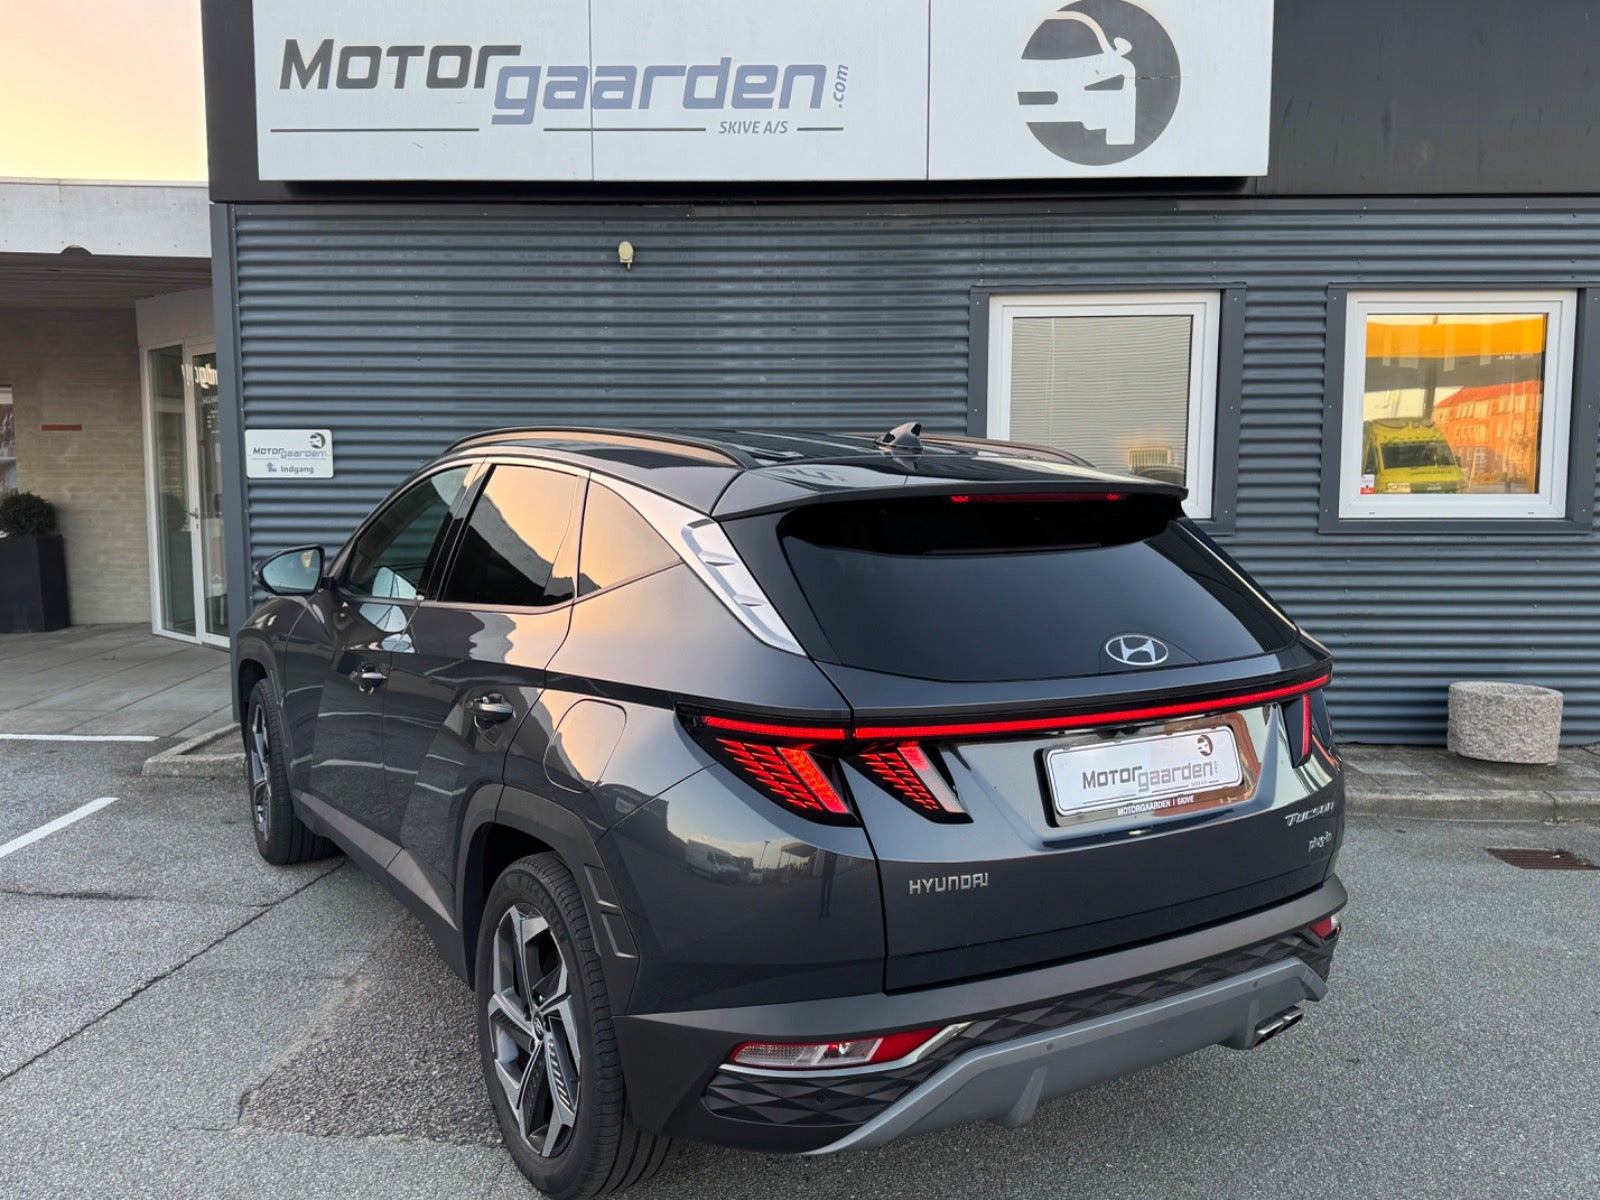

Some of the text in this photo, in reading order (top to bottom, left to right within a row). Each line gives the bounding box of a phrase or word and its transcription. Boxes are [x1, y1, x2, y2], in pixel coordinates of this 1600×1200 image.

[833, 64, 849, 109] .com
[718, 120, 789, 134] SKIVE A/S
[280, 465, 315, 475] Indgang
[1117, 800, 1172, 817] MOTORGAARDEN
[1177, 795, 1195, 806] SKIVE
[908, 872, 989, 895] HYUNDAI
